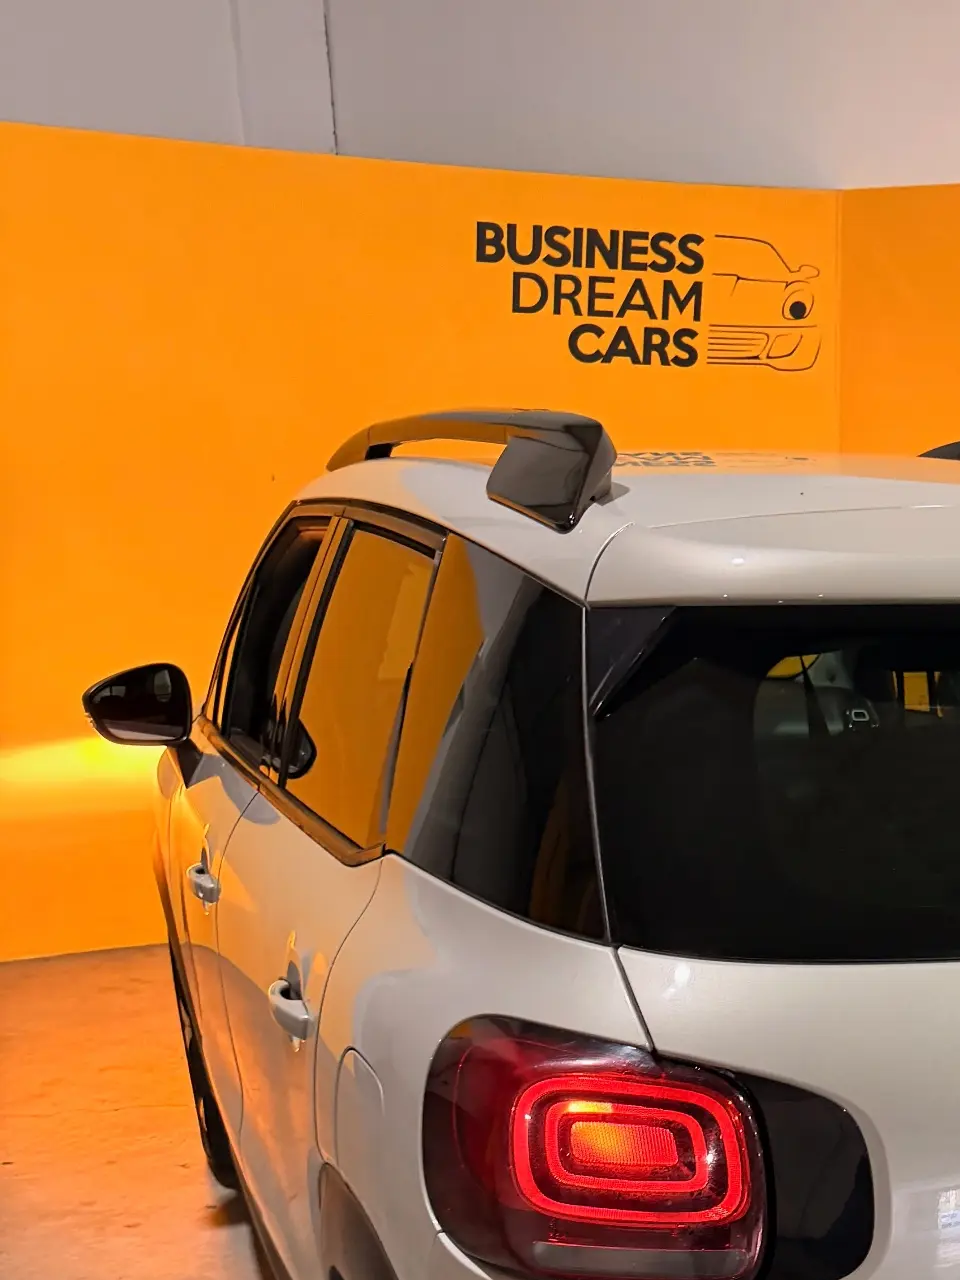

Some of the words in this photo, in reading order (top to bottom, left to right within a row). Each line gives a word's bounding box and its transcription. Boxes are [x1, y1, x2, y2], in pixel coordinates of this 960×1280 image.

[476, 221, 704, 274] BUSINESS
[511, 271, 703, 322] DREAM
[568, 323, 699, 368] CARS
